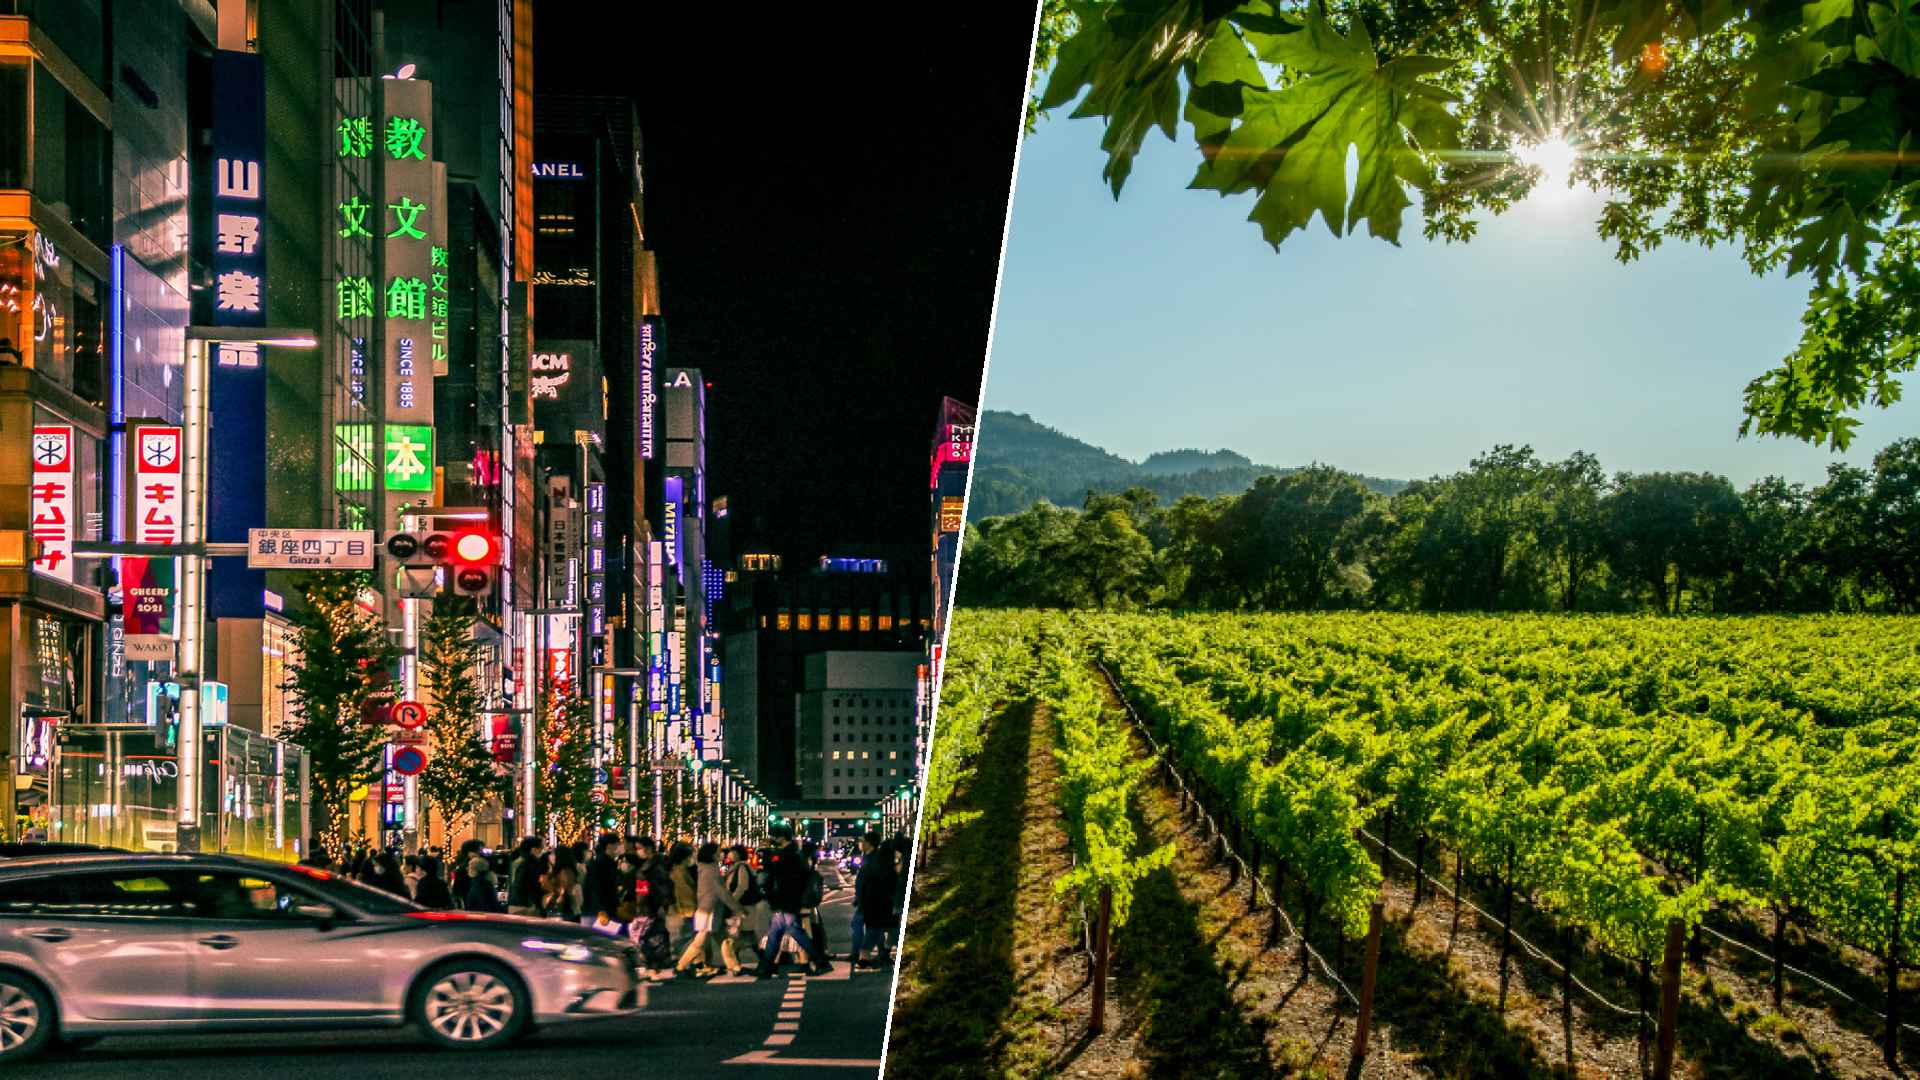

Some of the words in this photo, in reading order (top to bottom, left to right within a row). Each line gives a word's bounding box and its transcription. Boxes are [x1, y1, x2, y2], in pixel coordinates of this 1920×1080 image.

[384, 115, 427, 320] 教文館
[399, 338, 414, 376] SINCE
[399, 381, 414, 409] 1885
[387, 436, 426, 481] 本
[258, 530, 292, 538] 中央区
[258, 540, 365, 556] 銀座四丁目
[289, 556, 320, 565] Ginza
[324, 555, 332, 565] 4
[129, 587, 169, 596] CHEERS
[137, 604, 163, 613] 2021
[134, 643, 168, 652] WAKO
